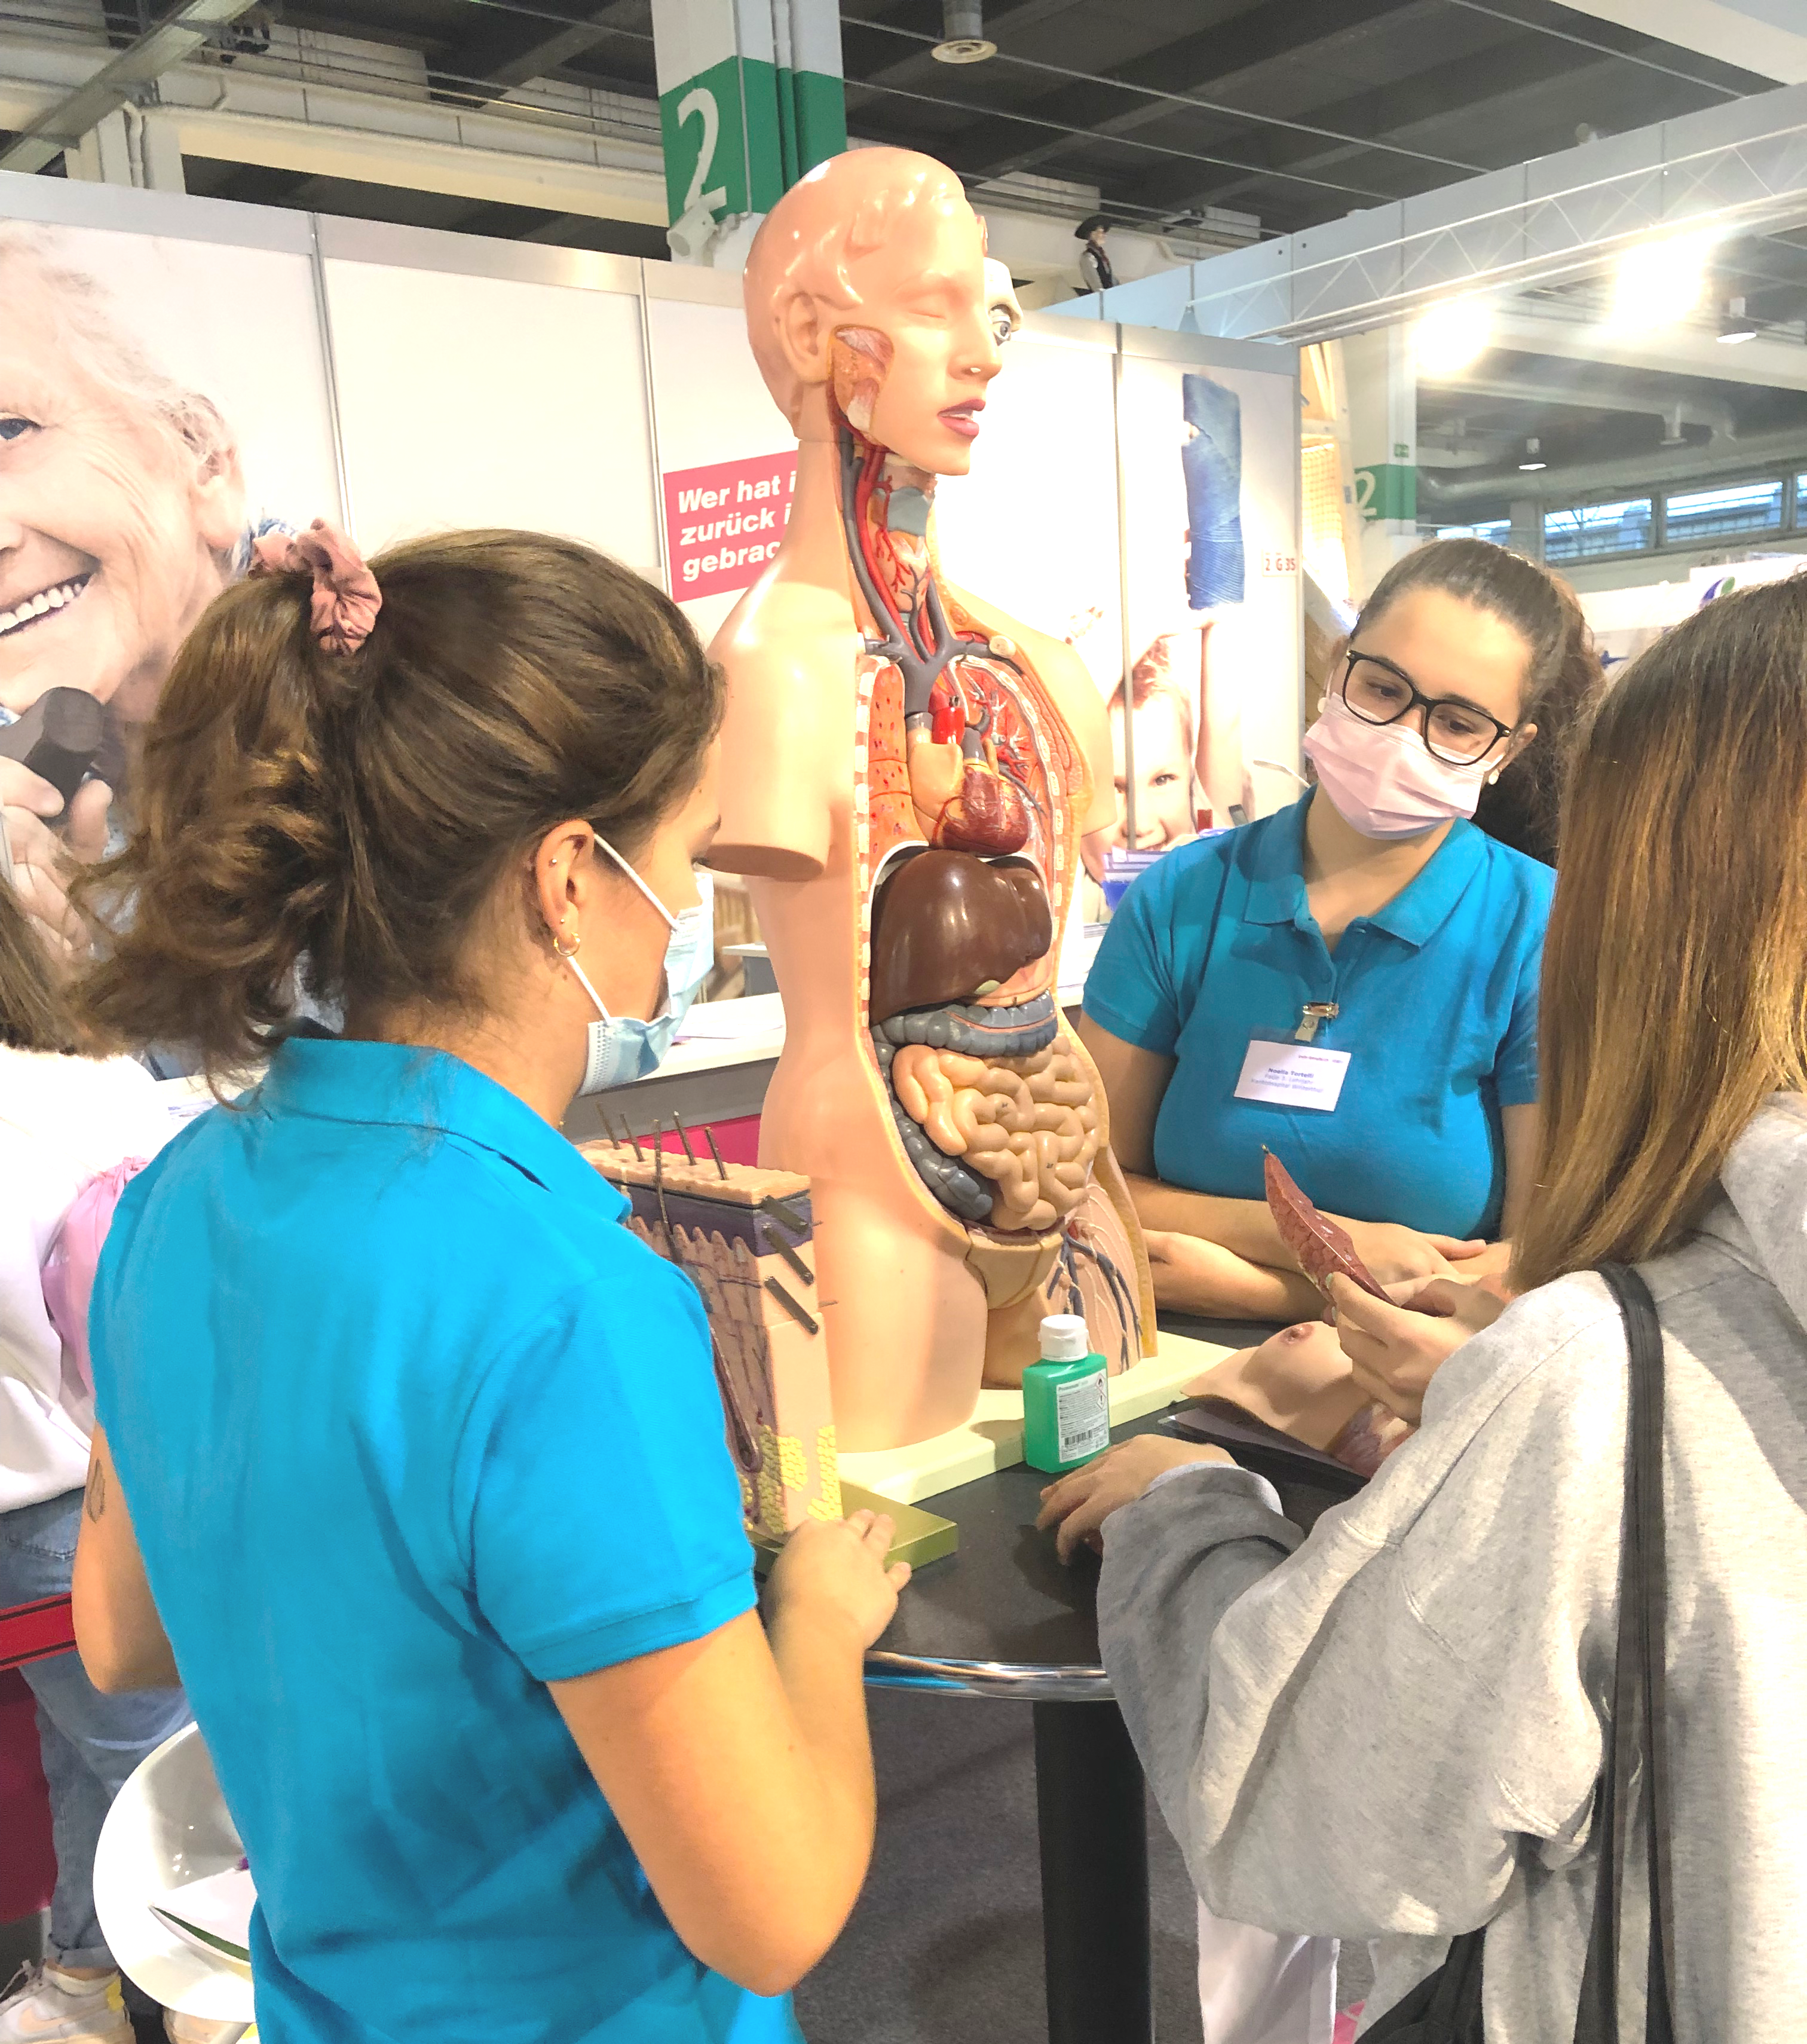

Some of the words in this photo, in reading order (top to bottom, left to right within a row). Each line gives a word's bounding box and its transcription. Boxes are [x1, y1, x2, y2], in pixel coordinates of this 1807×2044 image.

[677, 87, 727, 213] 2
[678, 487, 730, 513] Wer
[737, 475, 781, 503] hat
[1353, 470, 1377, 517] 2
[680, 507, 776, 546] zurück
[1265, 558, 1270, 571] 2
[1275, 558, 1283, 571] G
[1285, 558, 1295, 571] 35
